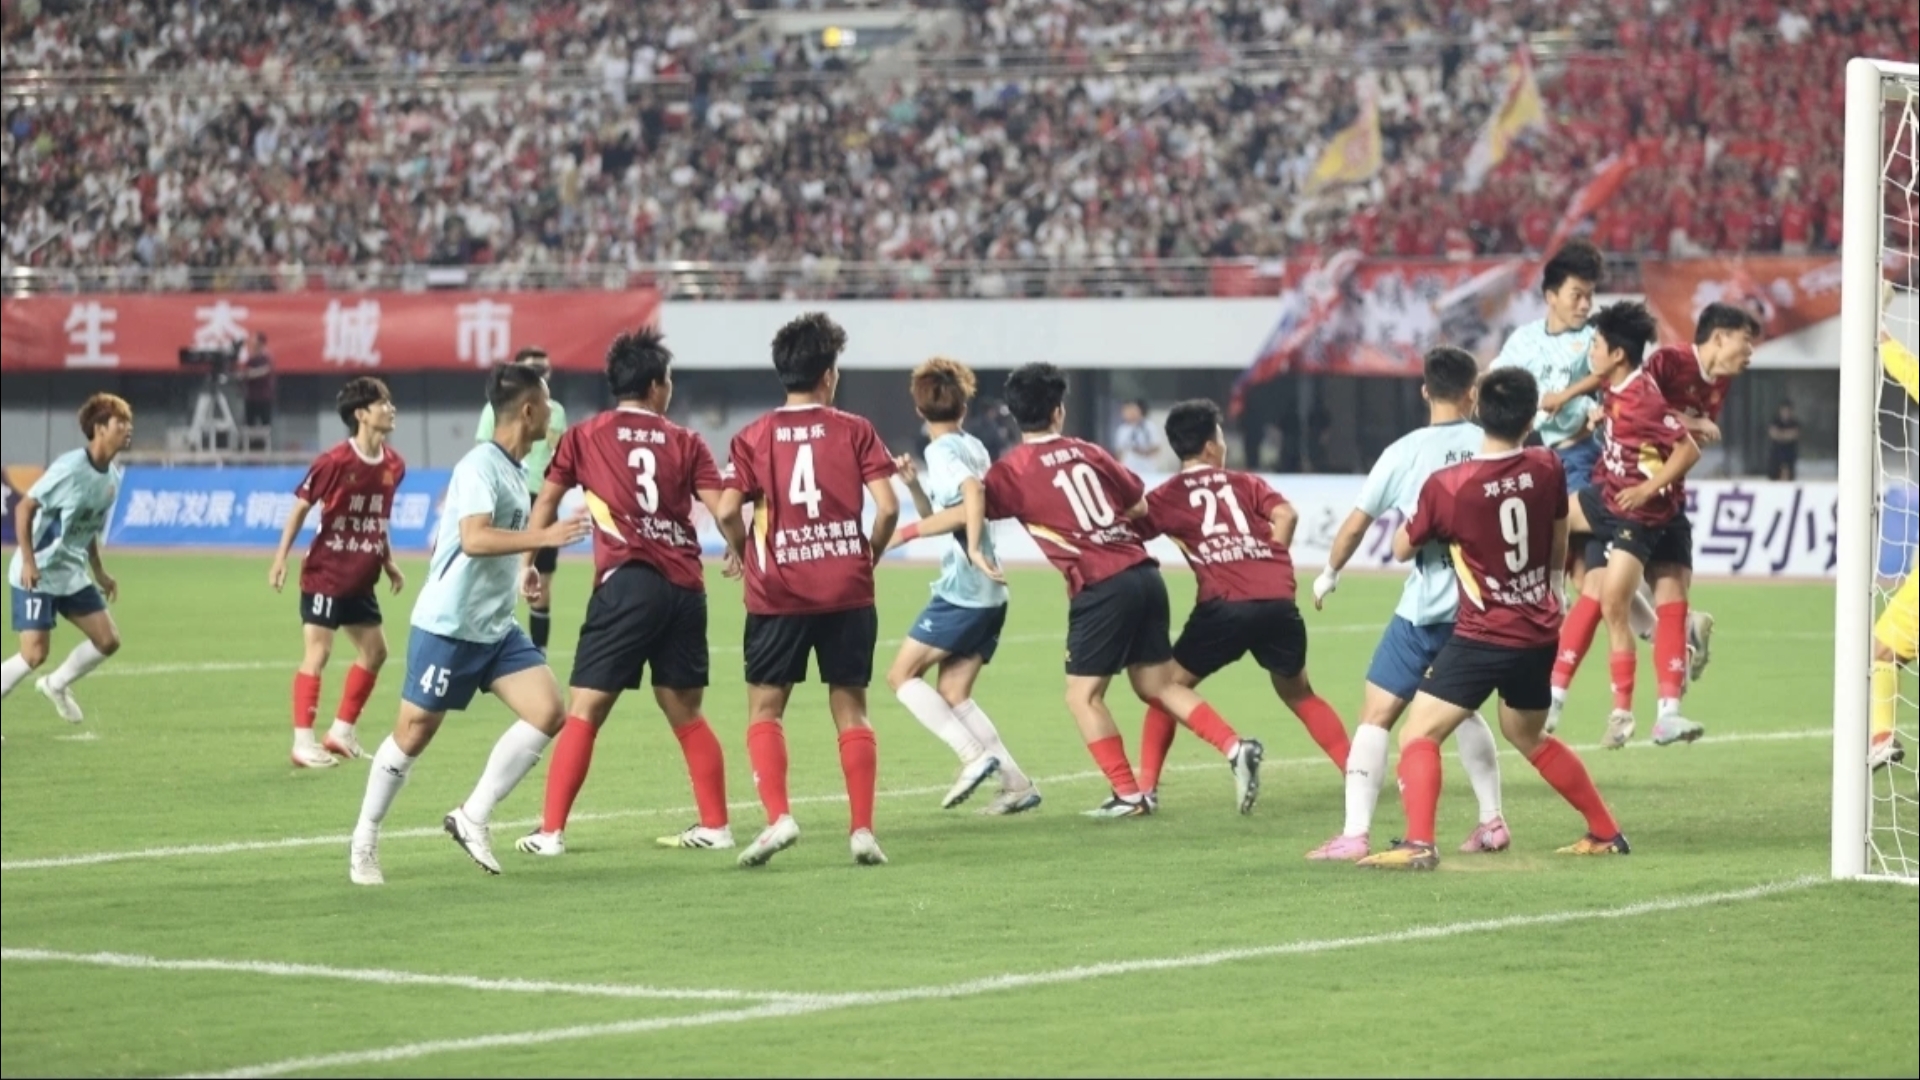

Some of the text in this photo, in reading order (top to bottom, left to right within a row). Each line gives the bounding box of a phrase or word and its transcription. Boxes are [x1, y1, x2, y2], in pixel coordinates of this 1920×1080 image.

[63, 299, 514, 368] 生态城市
[628, 447, 658, 514] 3
[789, 443, 822, 519] 4
[1052, 463, 1115, 532] 10
[1189, 484, 1251, 537] 21
[1499, 497, 1529, 573] 9
[25, 598, 42, 621] 17
[312, 593, 333, 619] 91
[420, 664, 451, 698] 45
